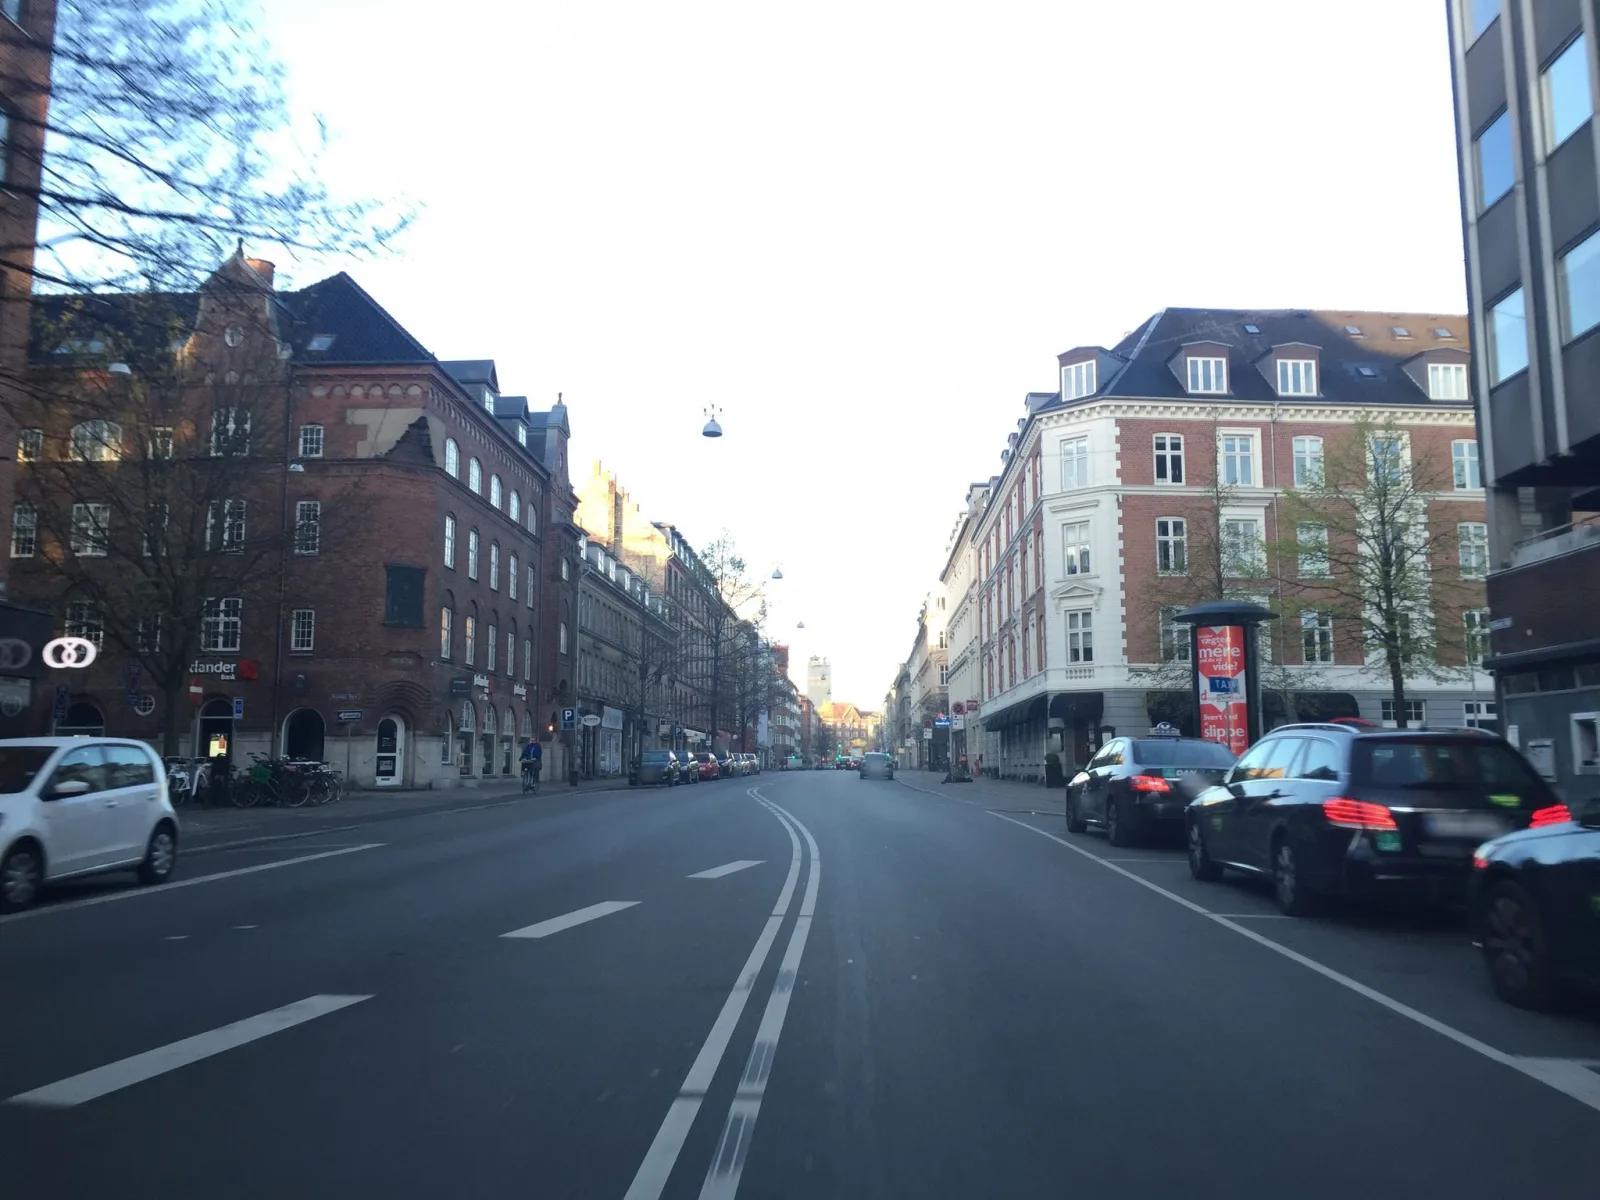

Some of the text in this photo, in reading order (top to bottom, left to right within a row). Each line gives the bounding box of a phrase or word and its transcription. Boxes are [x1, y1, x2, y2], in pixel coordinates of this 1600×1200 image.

[1199, 647, 1240, 658] mere
[1212, 661, 1238, 671] vide?
[564, 710, 573, 721] P
[1204, 725, 1245, 742] slippe
